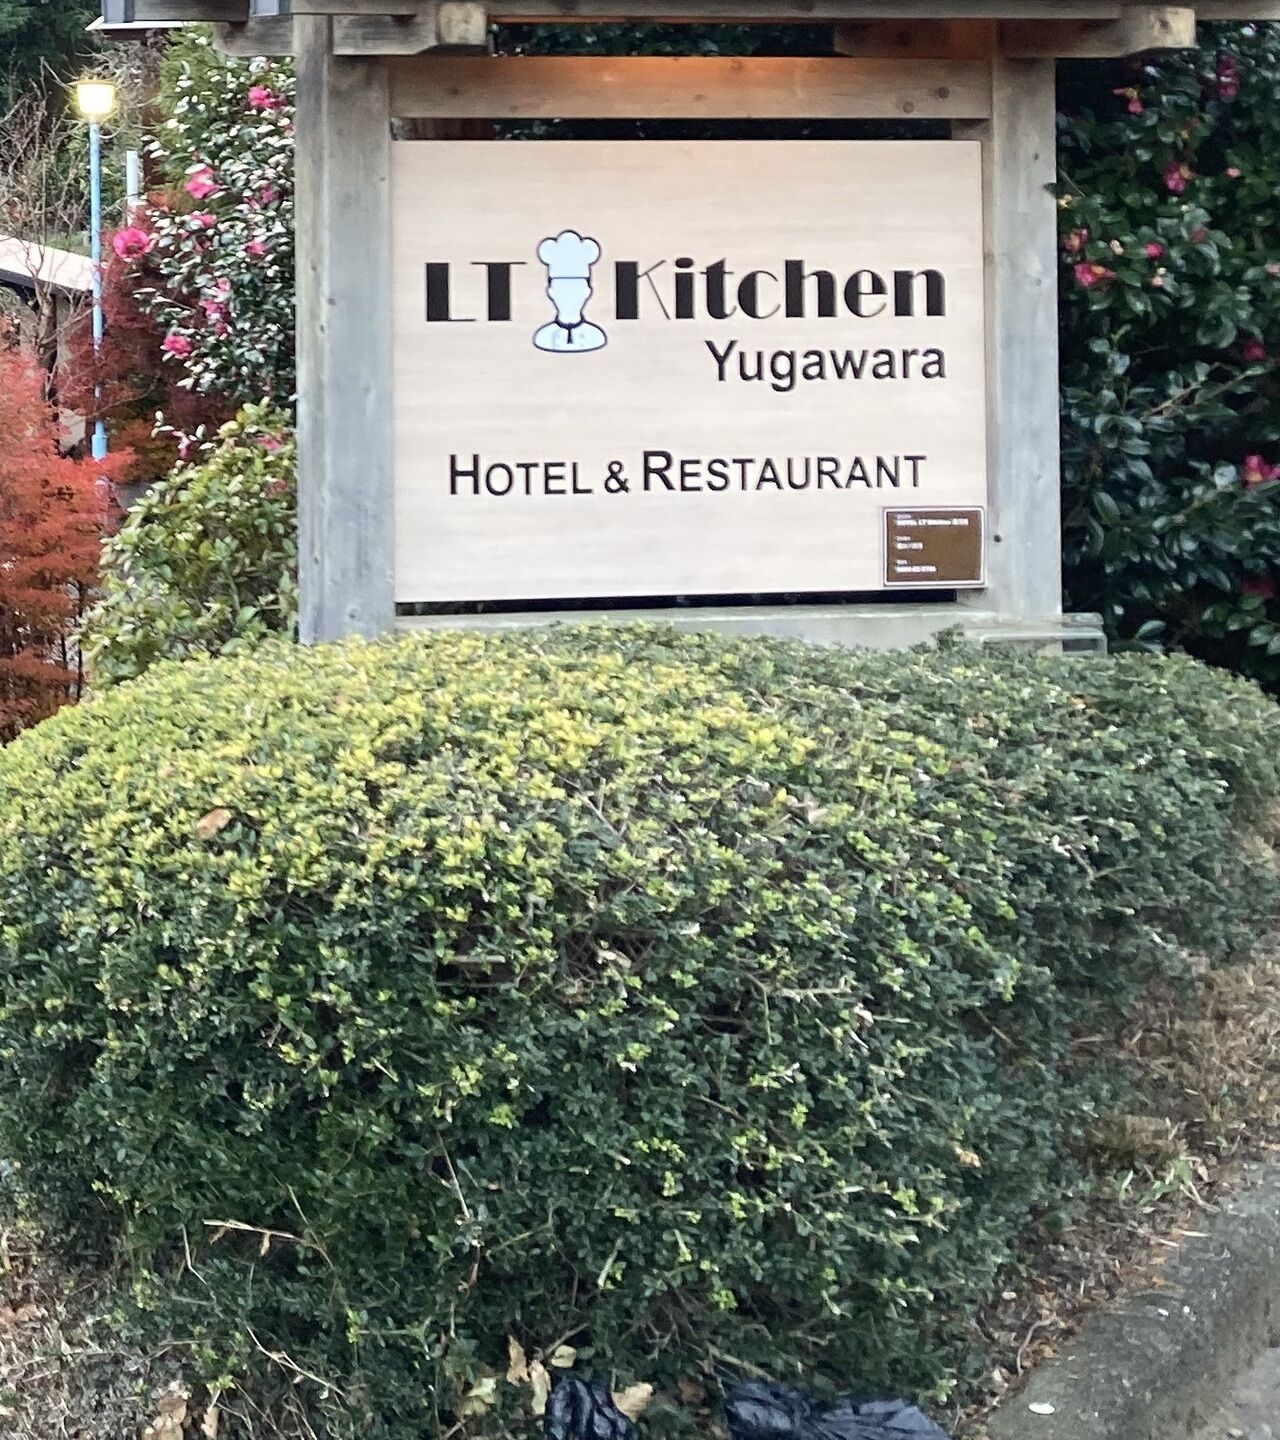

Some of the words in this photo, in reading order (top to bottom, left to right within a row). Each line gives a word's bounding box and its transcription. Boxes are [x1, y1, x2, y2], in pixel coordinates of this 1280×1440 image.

[425, 261, 527, 322] LT
[614, 257, 946, 320] Kitchen
[704, 339, 946, 392] Yugawara
[449, 454, 593, 496] HOTEL
[603, 461, 630, 494] &
[642, 450, 927, 492] RESTAURANT
